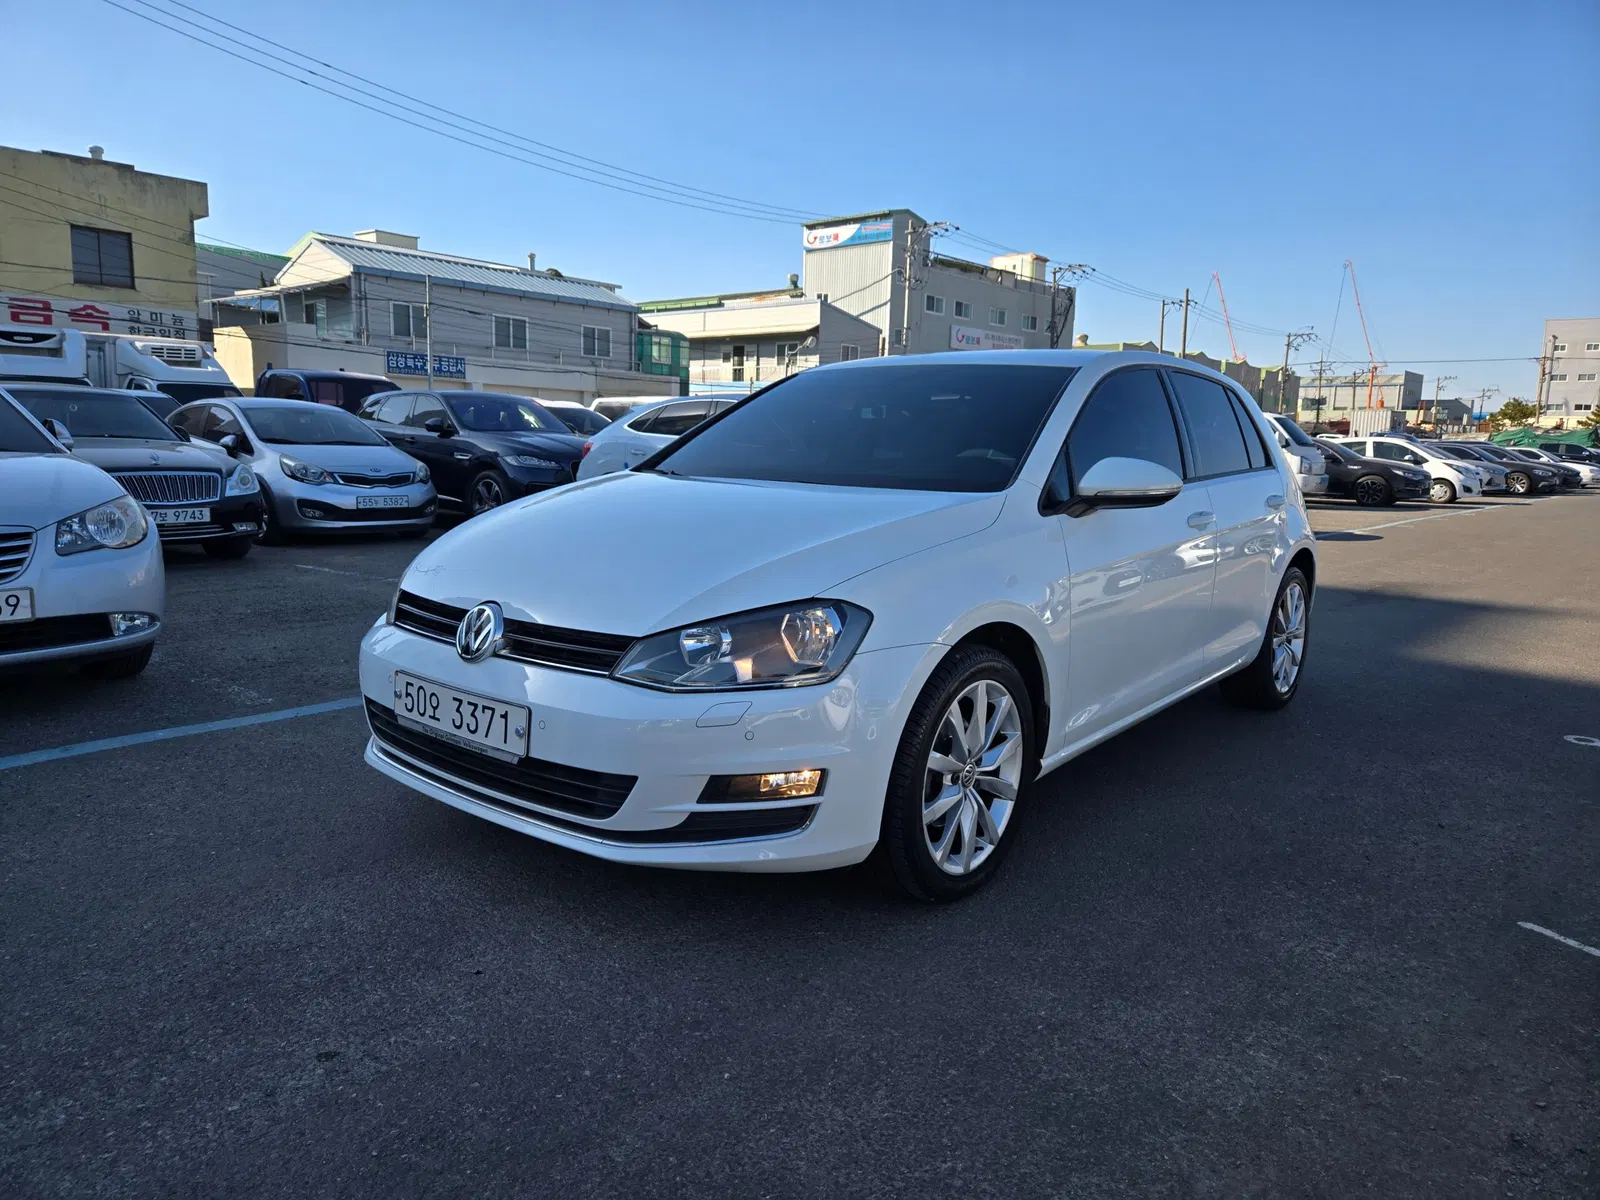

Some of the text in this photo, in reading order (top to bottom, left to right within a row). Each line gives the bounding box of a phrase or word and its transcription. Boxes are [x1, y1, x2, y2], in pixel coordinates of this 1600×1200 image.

[384, 497, 405, 506] 5382
[151, 510, 204, 522] 7보 9743
[0, 594, 20, 616] 9
[404, 680, 509, 744] 50오 3371
